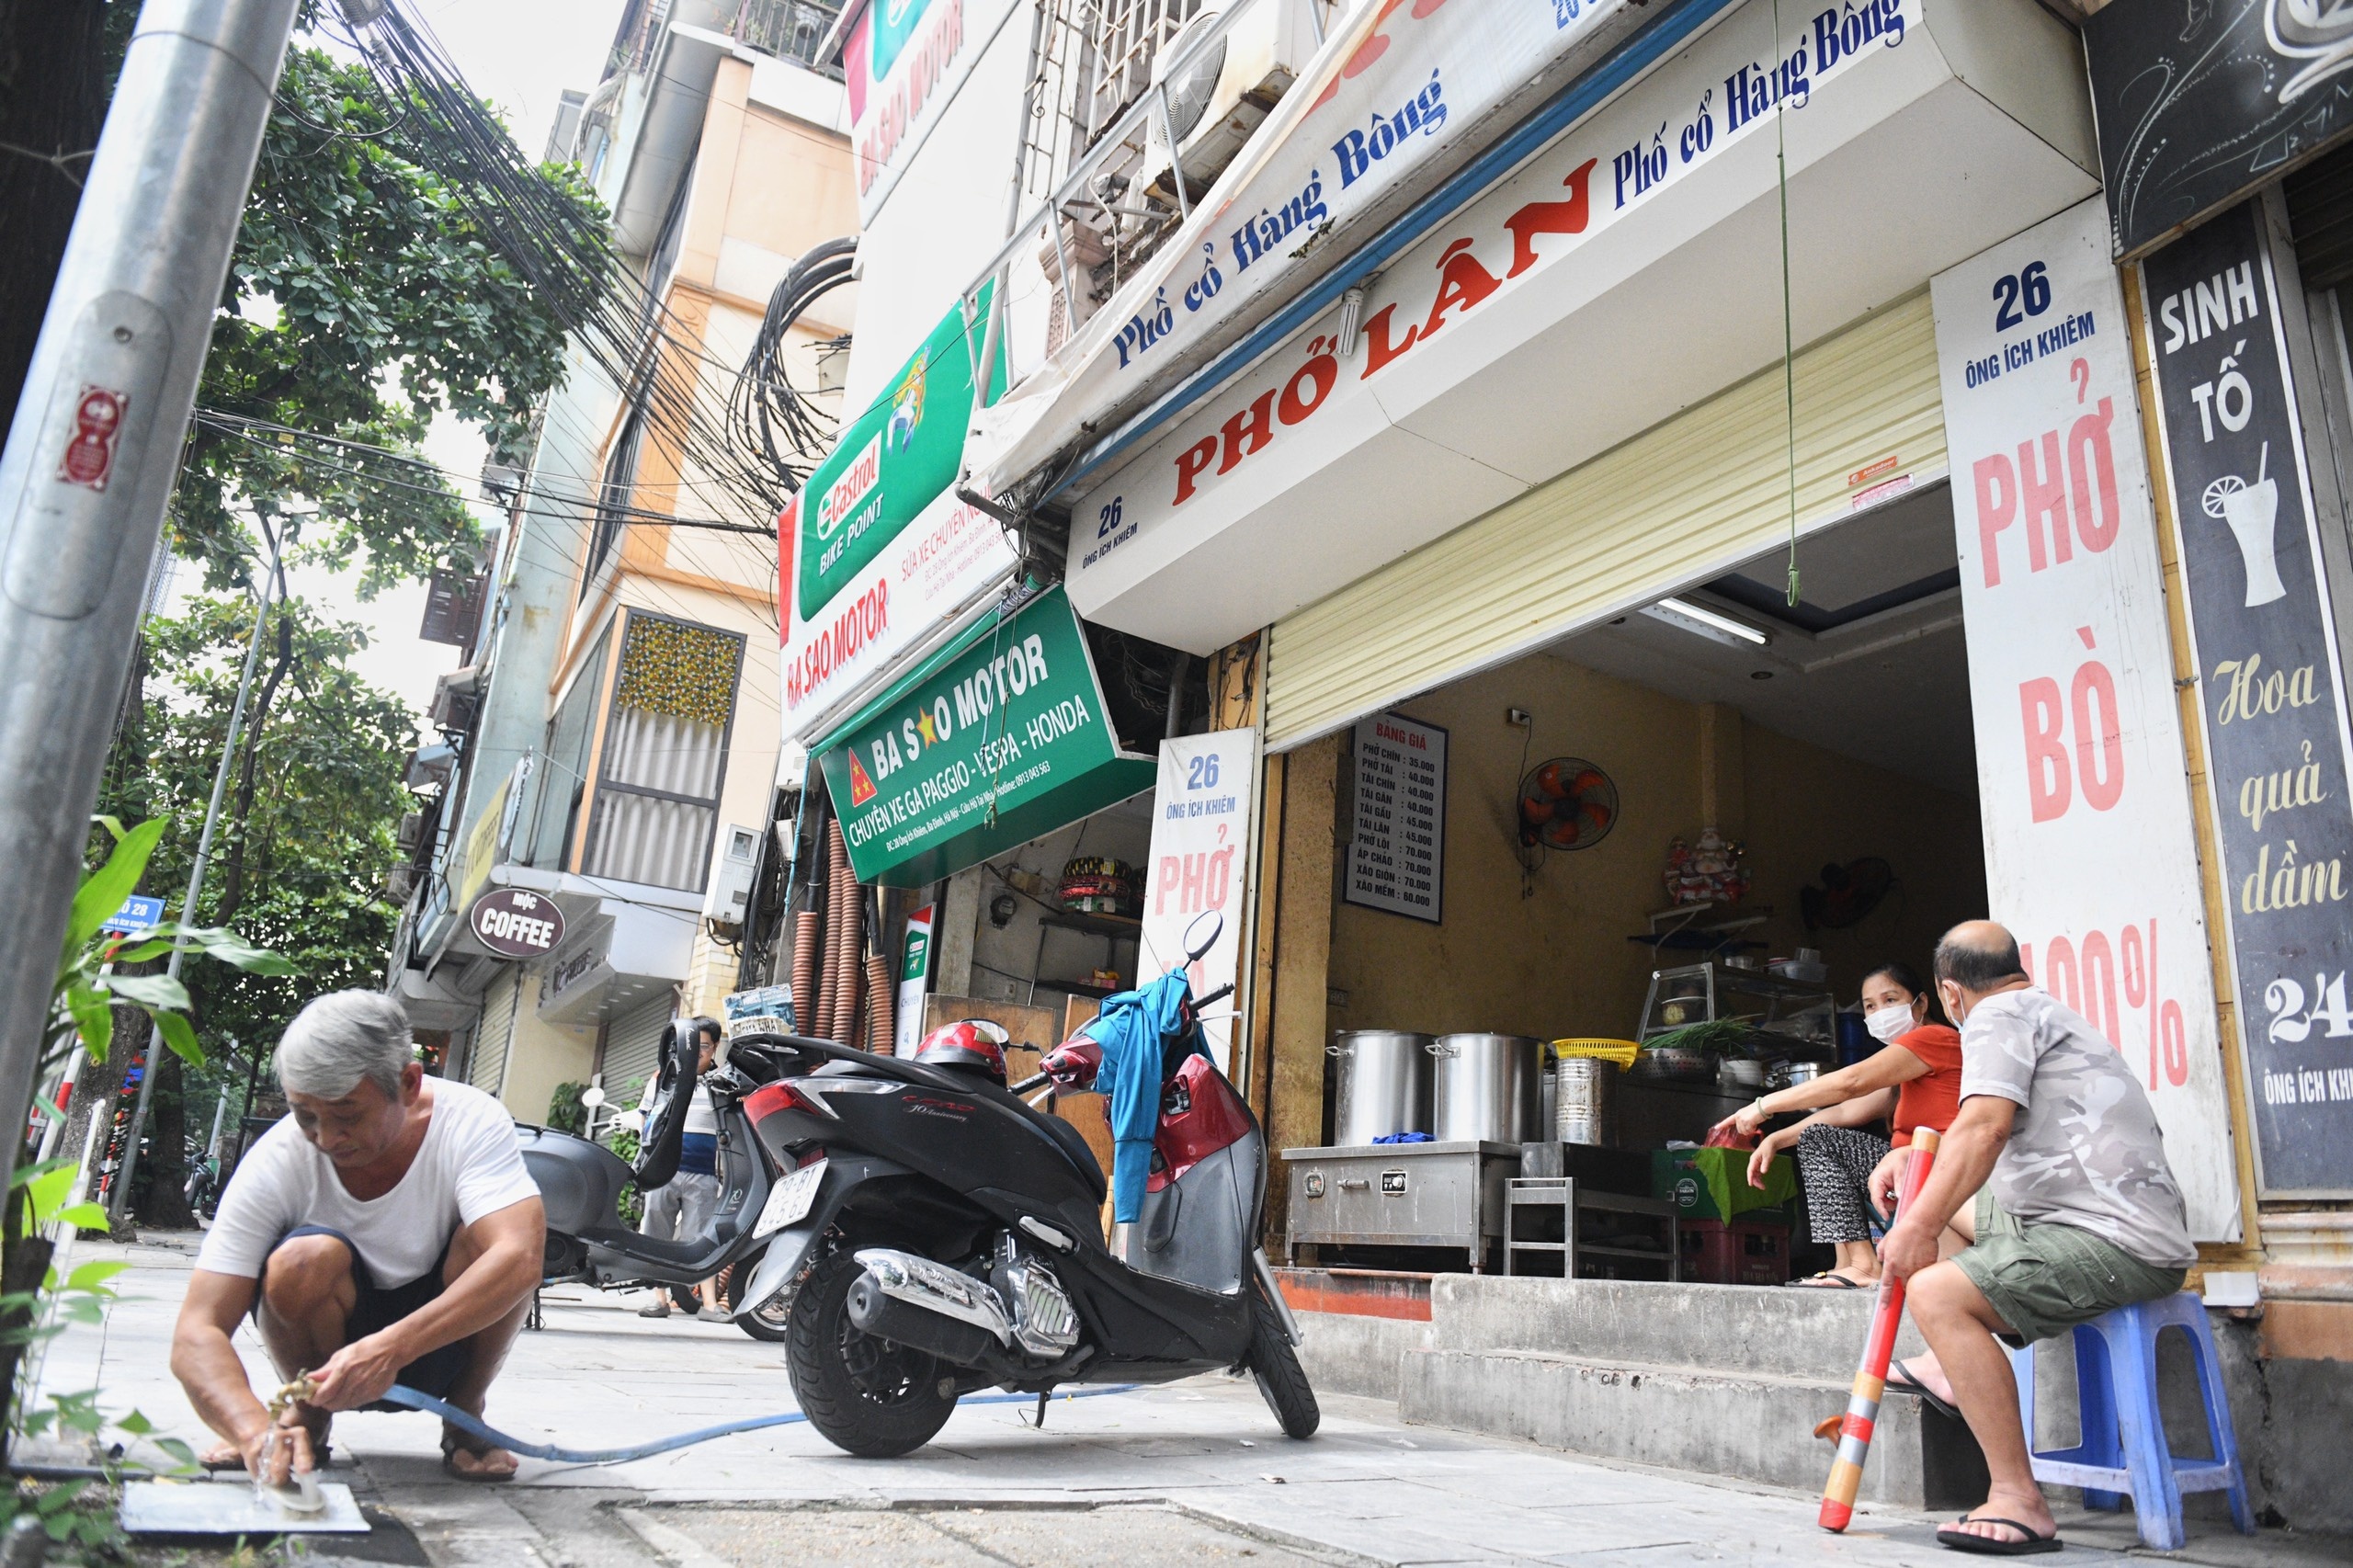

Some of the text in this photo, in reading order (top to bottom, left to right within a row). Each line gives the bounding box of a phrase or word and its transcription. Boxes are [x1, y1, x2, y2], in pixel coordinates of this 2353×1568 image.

[1112, 286, 1174, 370] Phố
[1184, 242, 1222, 312] cổ
[1230, 169, 1327, 275] Hàng
[1330, 68, 1448, 190] Bông
[1172, 0, 1904, 506] PHỞ LÂN Phố cổ Hàng Bông
[1993, 260, 2051, 333] 26
[2161, 260, 2258, 355] SINH
[1965, 311, 2096, 389] ÔNG ÍCH KHIÊM
[2191, 338, 2253, 443] TỐ
[832, 444, 876, 522] Castrol
[1972, 357, 2120, 589] PHỞ
[820, 492, 884, 577] BIKE POINT
[1097, 495, 1122, 540] 26
[918, 539, 929, 567] XE
[1083, 522, 1138, 569] ÔNG ÍCH KHIÊM
[788, 578, 889, 710] BA SAO MOTOR
[871, 731, 904, 781] BA
[953, 633, 1049, 731] MOTOR
[2212, 653, 2321, 725] Hoa
[1376, 720, 1427, 751] BẢNG GIÁ
[2019, 625, 2124, 824] BÒ
[848, 806, 890, 846] CHUYÊN
[887, 796, 907, 826] XE
[905, 788, 924, 816] GA
[921, 760, 970, 809] PAGGIO
[973, 733, 1021, 778] VESPA
[1026, 694, 1090, 750] HONDA
[995, 781, 1016, 797] Hotline:
[1015, 770, 1030, 788] 0913
[1028, 765, 1040, 780] 043
[1039, 759, 1051, 775] 563
[1187, 753, 1219, 790] 26
[1361, 756, 1434, 788] PHỞ TÁI 40.000
[1362, 742, 1435, 773] PHỞ CHÍN 35.000
[1166, 795, 1235, 820] ÔNG ÍCH KHIÊM
[1360, 787, 1373, 801] TÁI
[1407, 801, 1433, 816] 40.000
[1361, 771, 1434, 801] TÁI CHÍN 40.000
[2240, 740, 2326, 832] quả
[1358, 817, 1371, 831] TÁI
[1405, 831, 1432, 846] 45.000
[1359, 801, 1372, 815] TÁI
[1406, 816, 1433, 832] 45.000
[1155, 823, 1234, 915] PHỞ
[1357, 846, 1431, 877] ÁP CHẢO 70.000
[1358, 832, 1375, 846] PHỞ
[1404, 846, 1431, 861] 70.000
[1356, 878, 1372, 892] XÀO
[1404, 891, 1430, 907] 60.000
[1357, 862, 1430, 892] XÀO GIÒN 70.000
[2242, 839, 2347, 915] dầm
[131, 903, 148, 916] 28
[512, 892, 538, 911] MỘC
[480, 907, 555, 949] COFFEE
[2265, 970, 2353, 1044] 24
[2264, 1068, 2296, 1105] ÔNG
[2299, 1065, 2325, 1103] ÍCH
